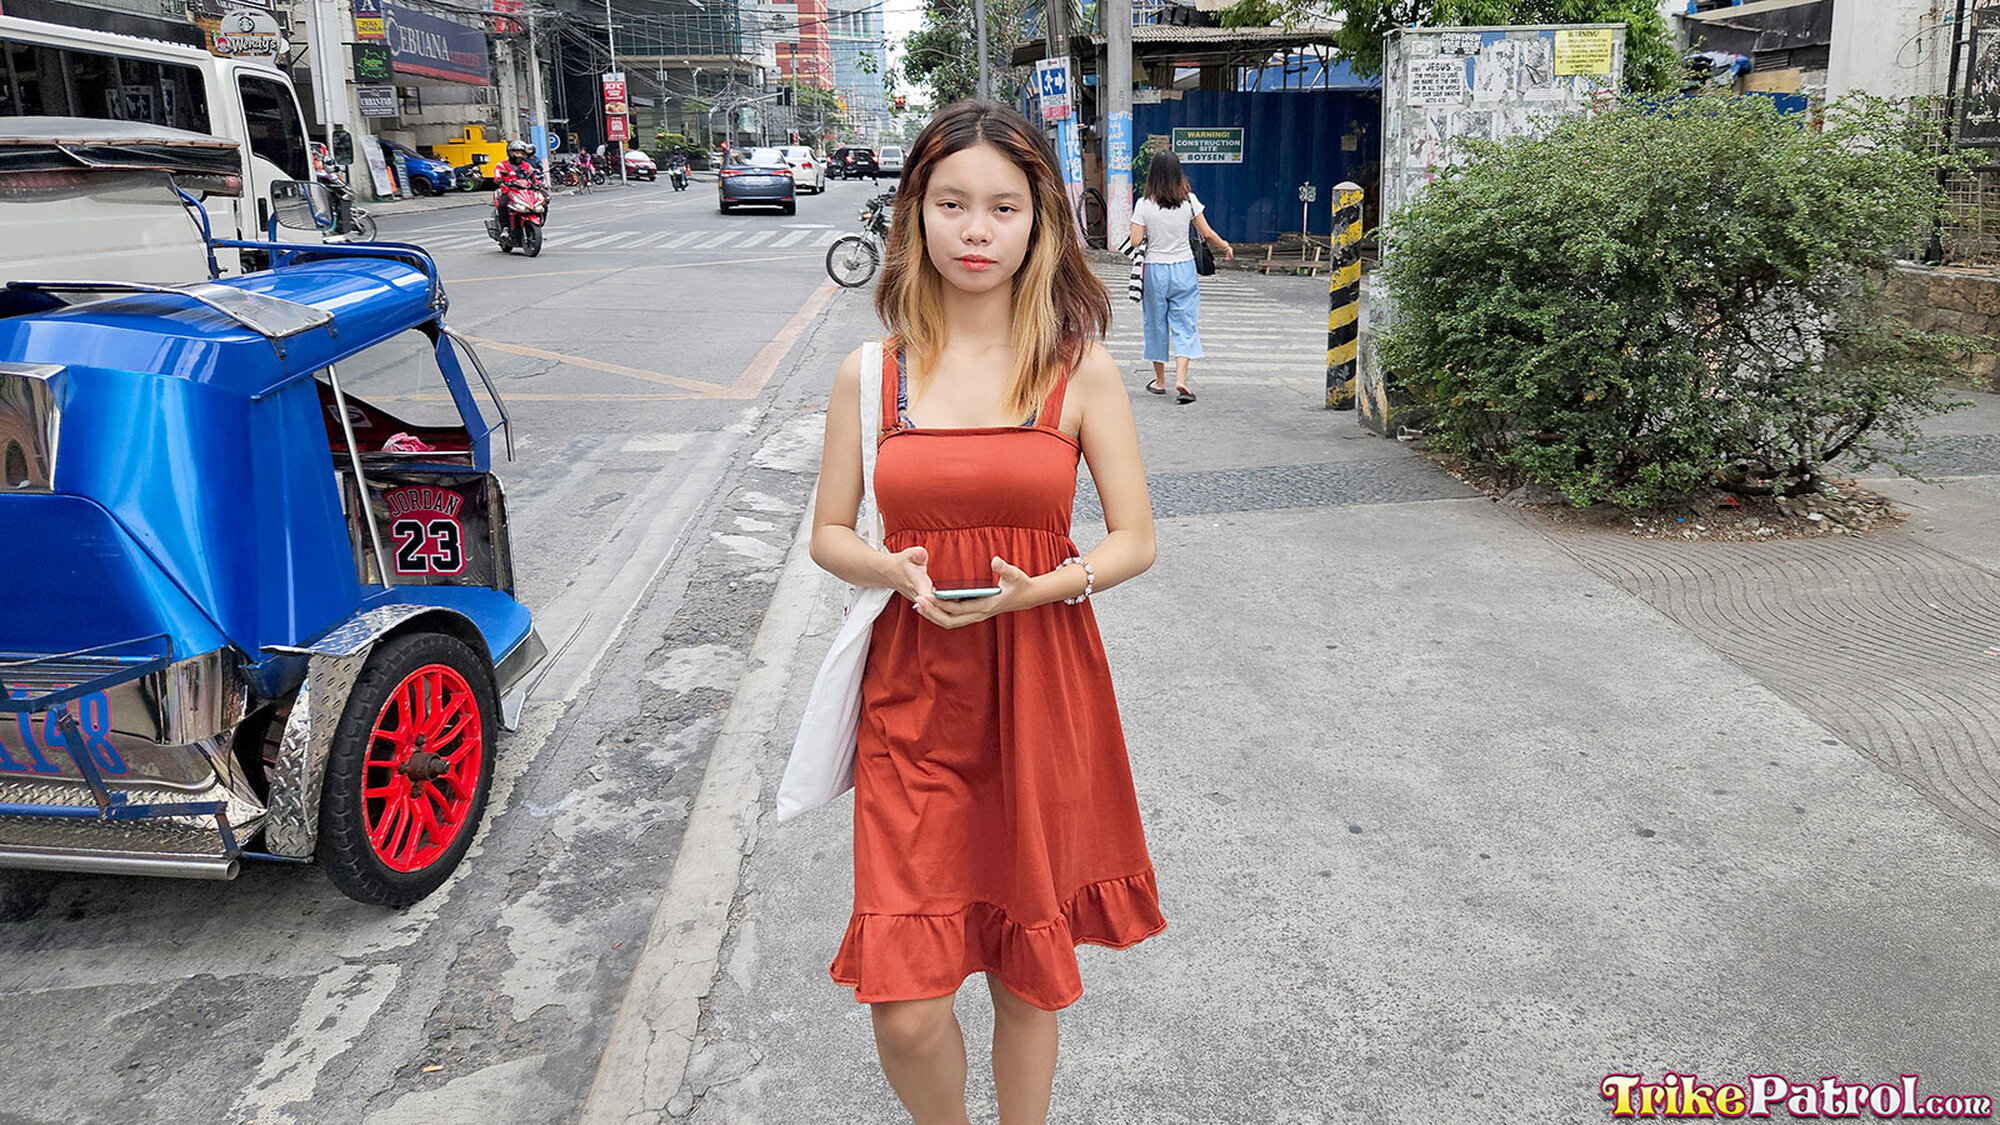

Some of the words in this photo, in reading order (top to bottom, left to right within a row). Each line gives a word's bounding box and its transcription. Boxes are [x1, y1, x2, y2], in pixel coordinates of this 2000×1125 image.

[232, 36, 278, 53] Wendy's
[386, 15, 450, 61] CEBUANA
[605, 82, 623, 90] KFC
[387, 488, 461, 518] JORDAN
[392, 519, 463, 573] 23
